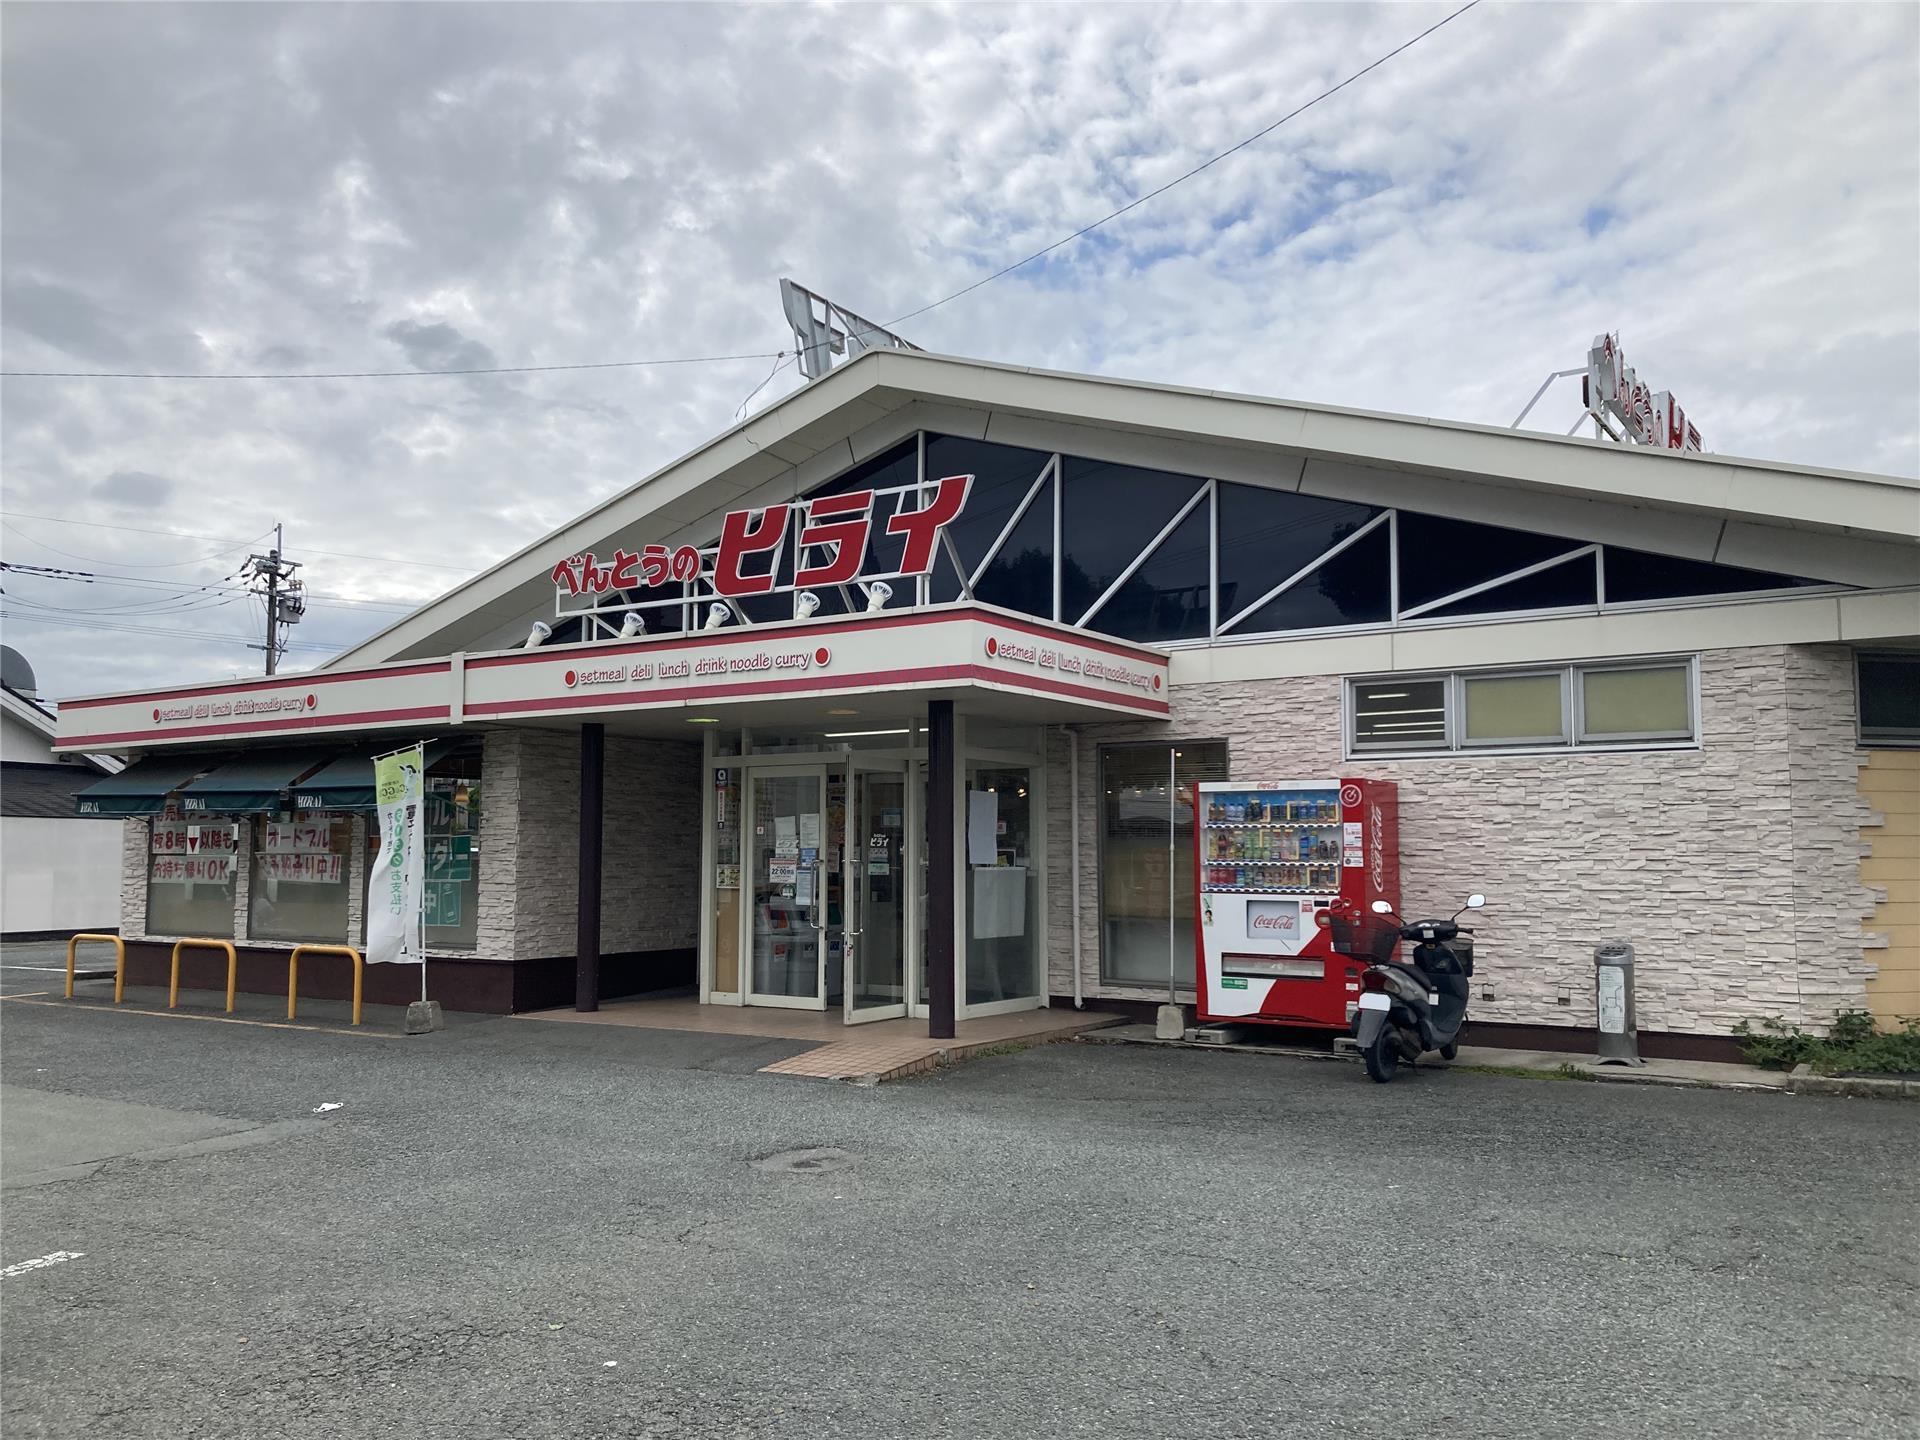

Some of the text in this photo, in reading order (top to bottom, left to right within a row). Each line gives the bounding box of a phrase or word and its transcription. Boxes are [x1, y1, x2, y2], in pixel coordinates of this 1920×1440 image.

[552, 474, 976, 598] べんとうの ヒライ
[579, 652, 811, 684] setmeal deli lunch drink noodle curry
[998, 643, 1151, 691] setmeal deli lunch drink noodle curry
[162, 697, 306, 720] setmeal deli lunch drink noodle curry
[297, 795, 323, 808] HIRAI
[870, 838, 889, 847] ヒライ
